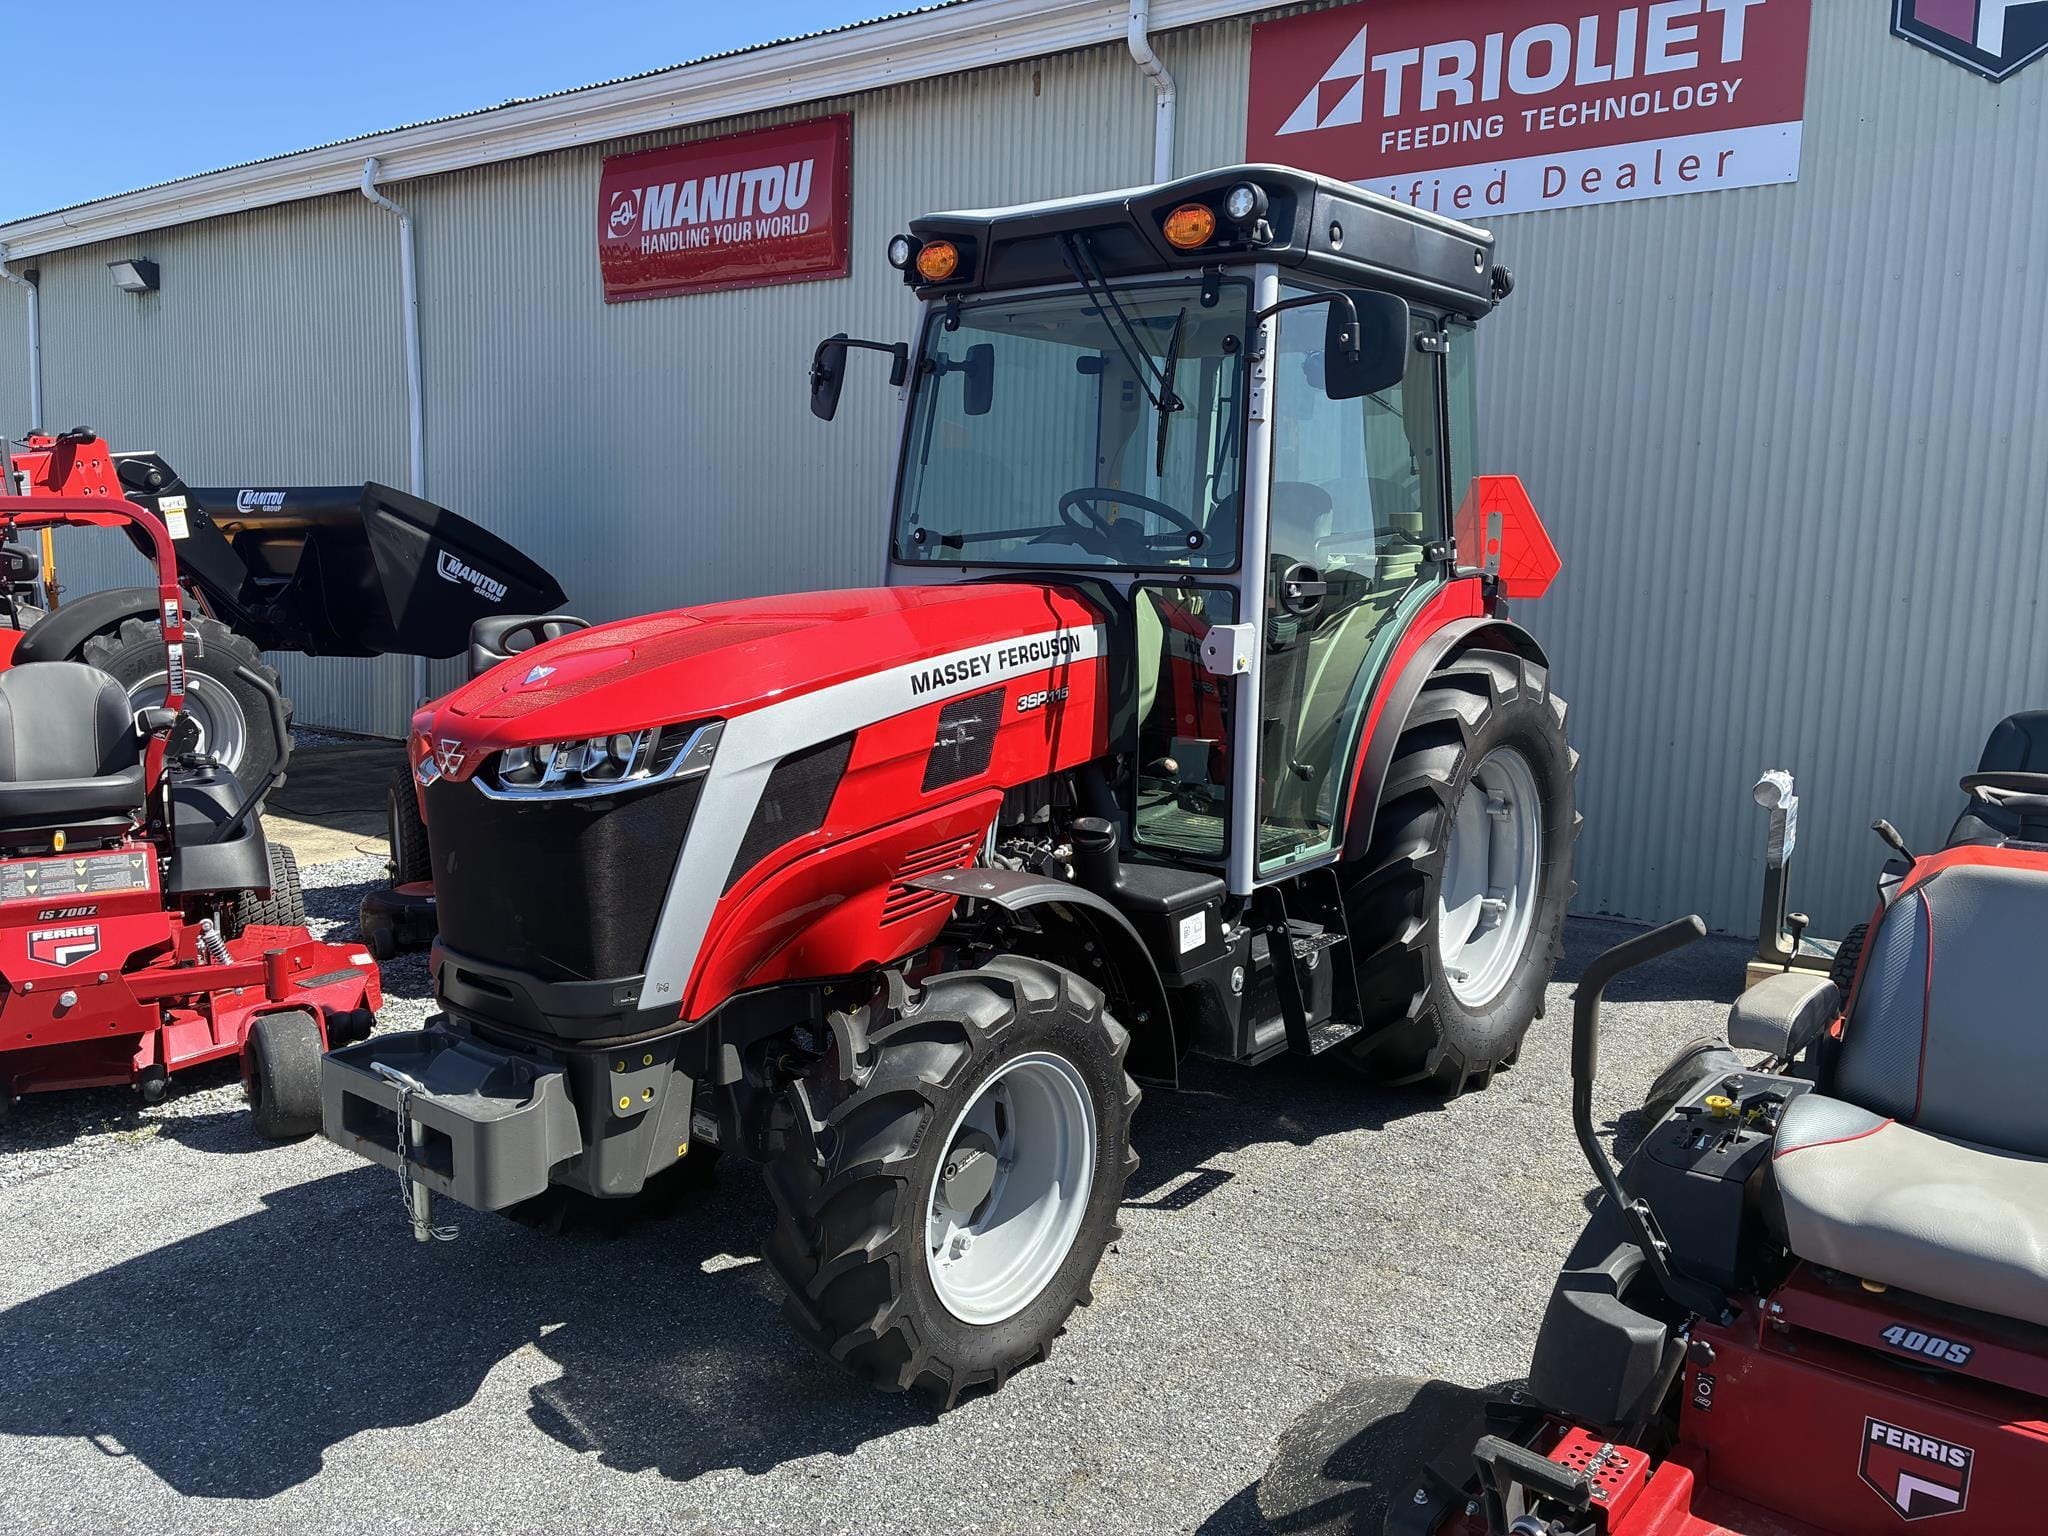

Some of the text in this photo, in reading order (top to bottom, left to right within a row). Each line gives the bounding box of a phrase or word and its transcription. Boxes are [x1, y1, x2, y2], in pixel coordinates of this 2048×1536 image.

[1371, 0, 1768, 118] TRIOLIET
[1381, 77, 1743, 154] FEEDING TECHNOLOGY
[641, 158, 815, 232] MANITOU
[1542, 147, 1735, 200] Dealer
[641, 212, 809, 255] HANDLING YOUR WORLD
[242, 491, 287, 505] MANITOU
[446, 558, 508, 598] MANITOU
[473, 586, 502, 602] GROUP
[910, 634, 1081, 696] MASSEY FERGUSON
[32, 926, 97, 941] FERRIS
[1882, 1326, 1972, 1364] 400S
[1870, 1422, 1966, 1468] FERRIS
